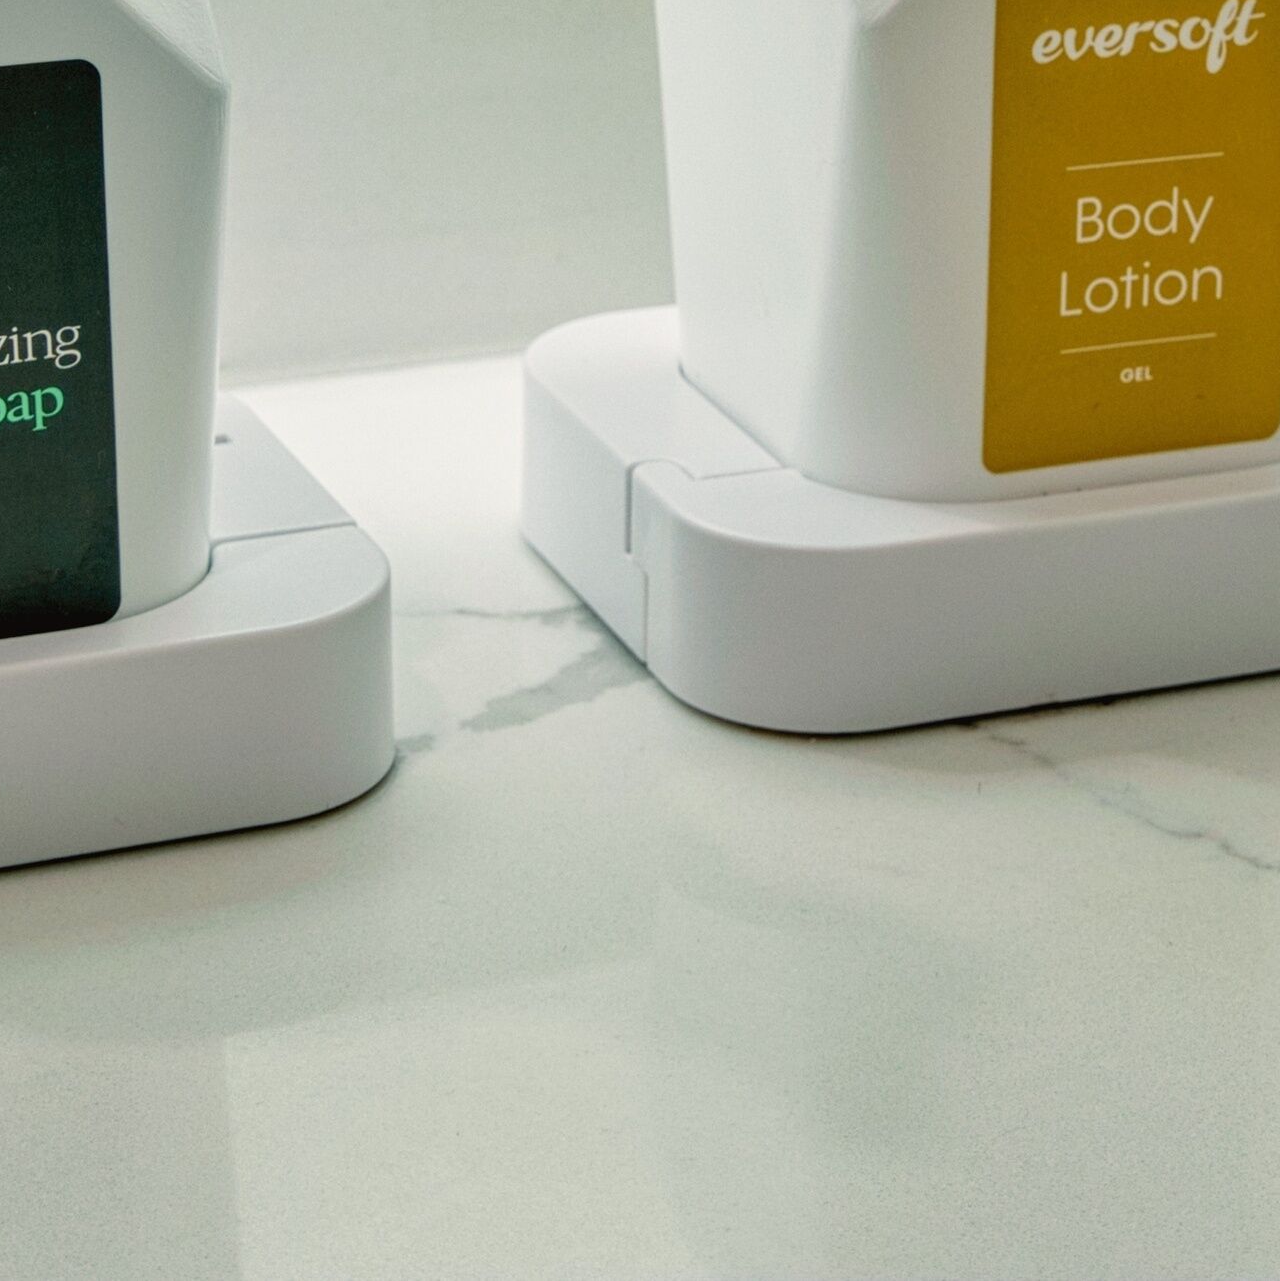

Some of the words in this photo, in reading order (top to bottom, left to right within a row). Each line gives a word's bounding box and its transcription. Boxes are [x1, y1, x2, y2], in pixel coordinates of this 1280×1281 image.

[1075, 186, 1215, 245] Body
[1059, 261, 1223, 318] Lotion
[1119, 365, 1154, 385] GEL
